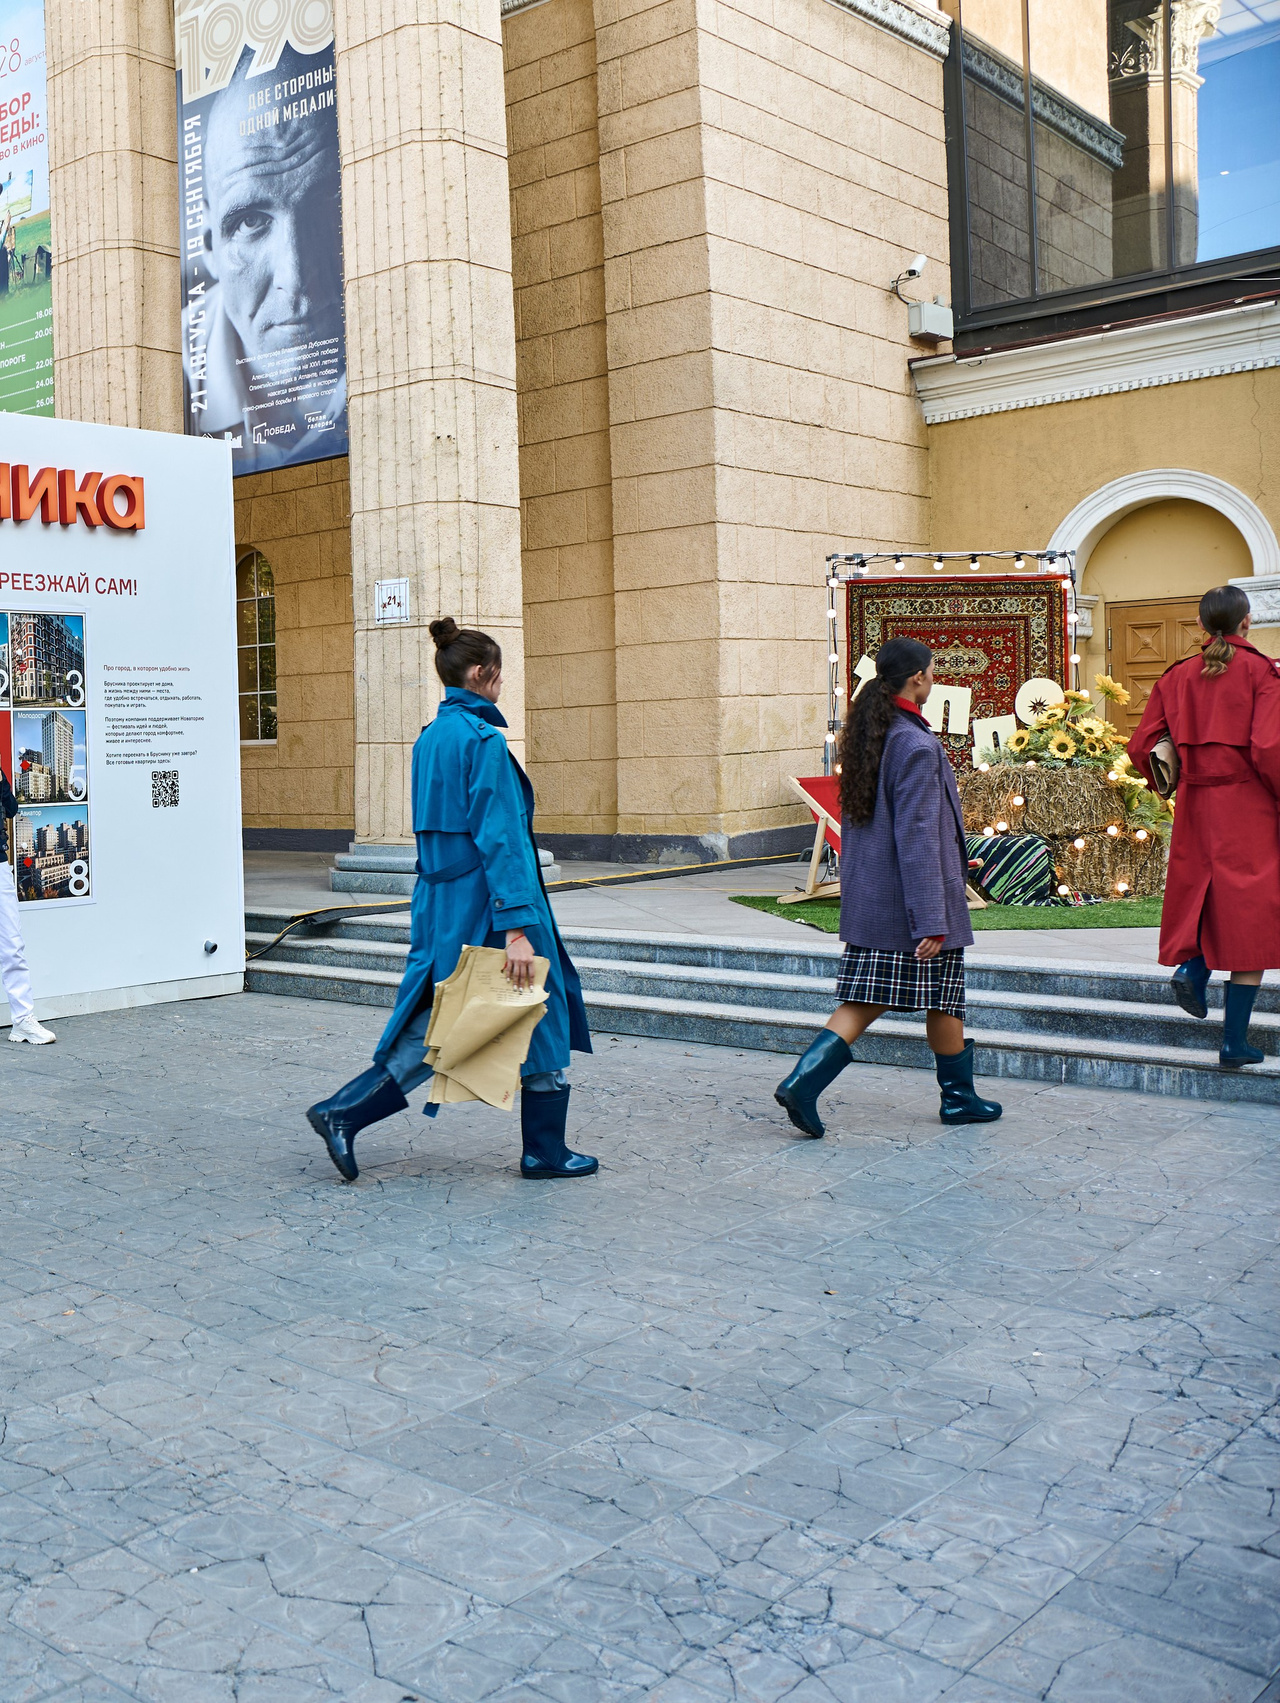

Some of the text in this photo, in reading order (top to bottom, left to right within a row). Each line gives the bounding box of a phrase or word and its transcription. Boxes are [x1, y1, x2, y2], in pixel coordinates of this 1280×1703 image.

[248, 65, 334, 110] ДВЕ СТОРОНЫ
[239, 89, 334, 136] ОДНОЙ МЕДАЛИ
[13, 145, 20, 158] В
[21, 132, 45, 154] КИНО
[184, 114, 208, 413] 21 АВГУСТА 19 СЕНТЯБРЯ
[36, 306, 52, 319] 18.08
[0, 354, 26, 369] ПОРОГЕ
[264, 424, 296, 436] ПОБЕДА
[307, 414, 326, 422] белая
[95, 577, 137, 596] САМ!
[387, 595, 397, 606] 21
[66, 670, 84, 707] 3
[68, 764, 87, 802] 5
[68, 859, 90, 896] 8
